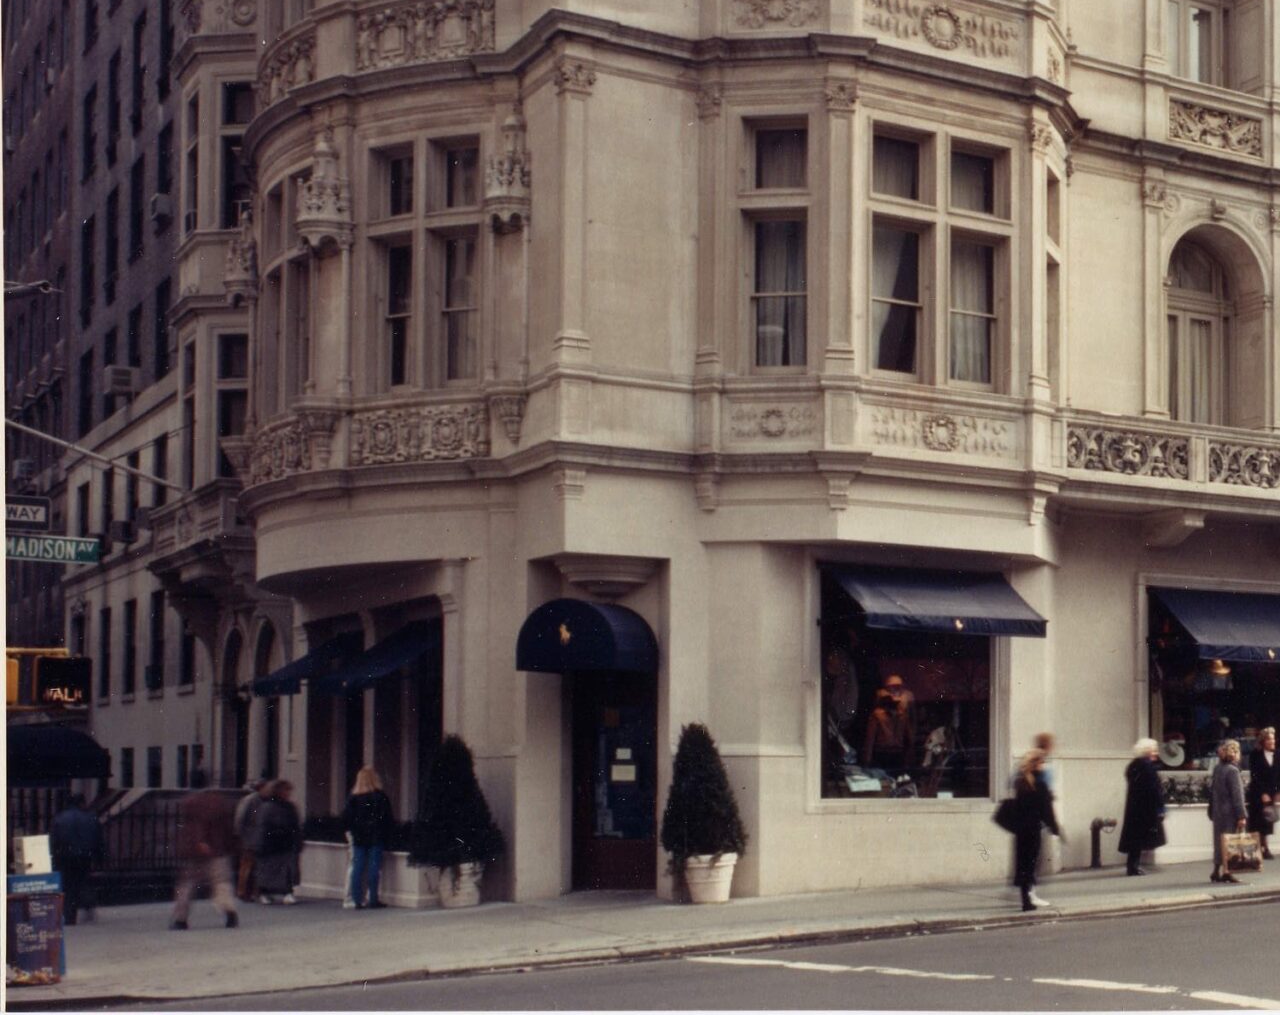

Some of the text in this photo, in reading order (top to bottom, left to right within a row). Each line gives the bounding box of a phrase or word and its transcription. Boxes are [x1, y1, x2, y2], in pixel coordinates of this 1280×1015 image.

[6, 505, 40, 520] WAY
[6, 536, 95, 560] MADISON AV
